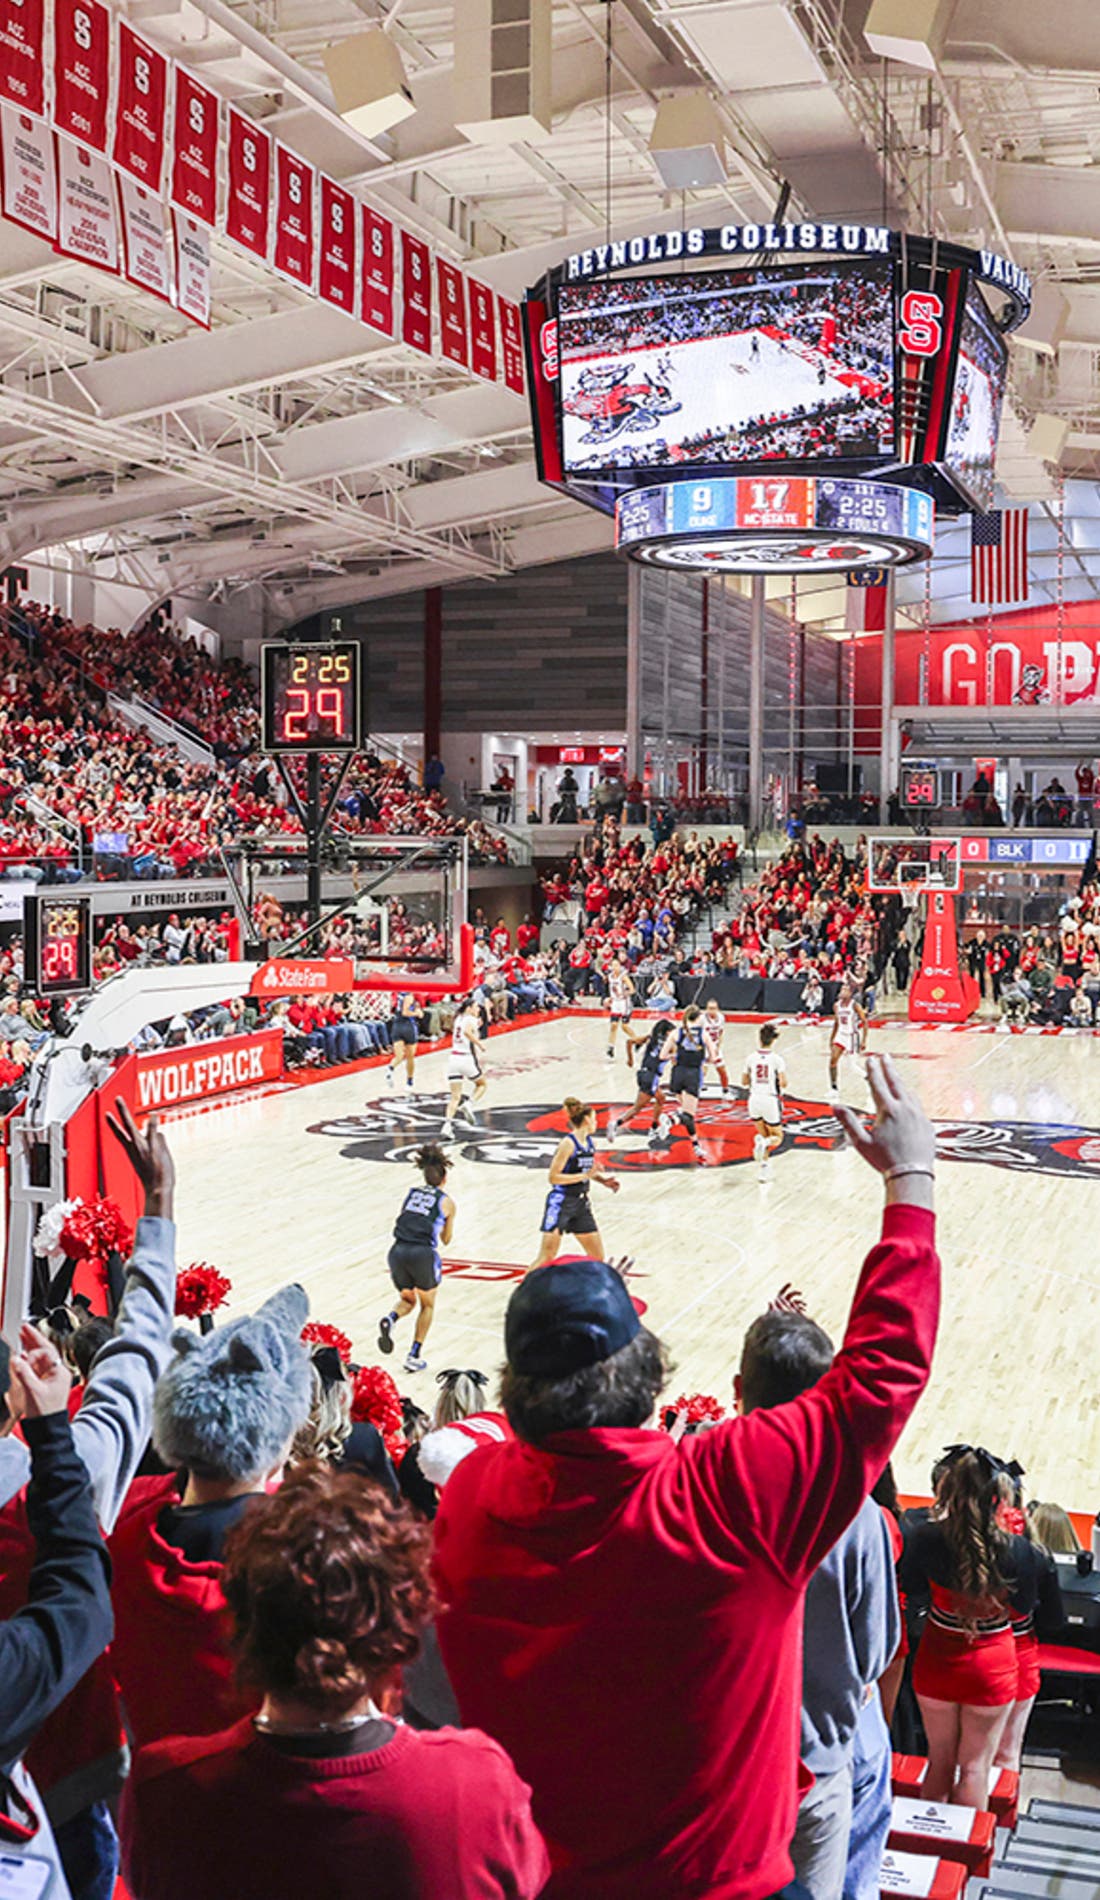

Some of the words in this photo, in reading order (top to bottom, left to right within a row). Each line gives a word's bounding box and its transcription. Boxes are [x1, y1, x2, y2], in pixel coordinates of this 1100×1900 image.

[568, 228, 705, 280] REYNOLDS
[720, 222, 890, 253] COLISEUM
[692, 486, 712, 512] 9
[750, 483, 789, 510] 17
[840, 496, 886, 517] 2:25
[293, 655, 351, 684] 2:25
[1043, 641, 1100, 705] P
[284, 687, 343, 739] 29
[907, 783, 933, 804] 29
[997, 844, 1024, 857] BLK
[46, 942, 73, 978] 29
[137, 1046, 265, 1106] WOLFPACK
[405, 1191, 436, 1217] 22
